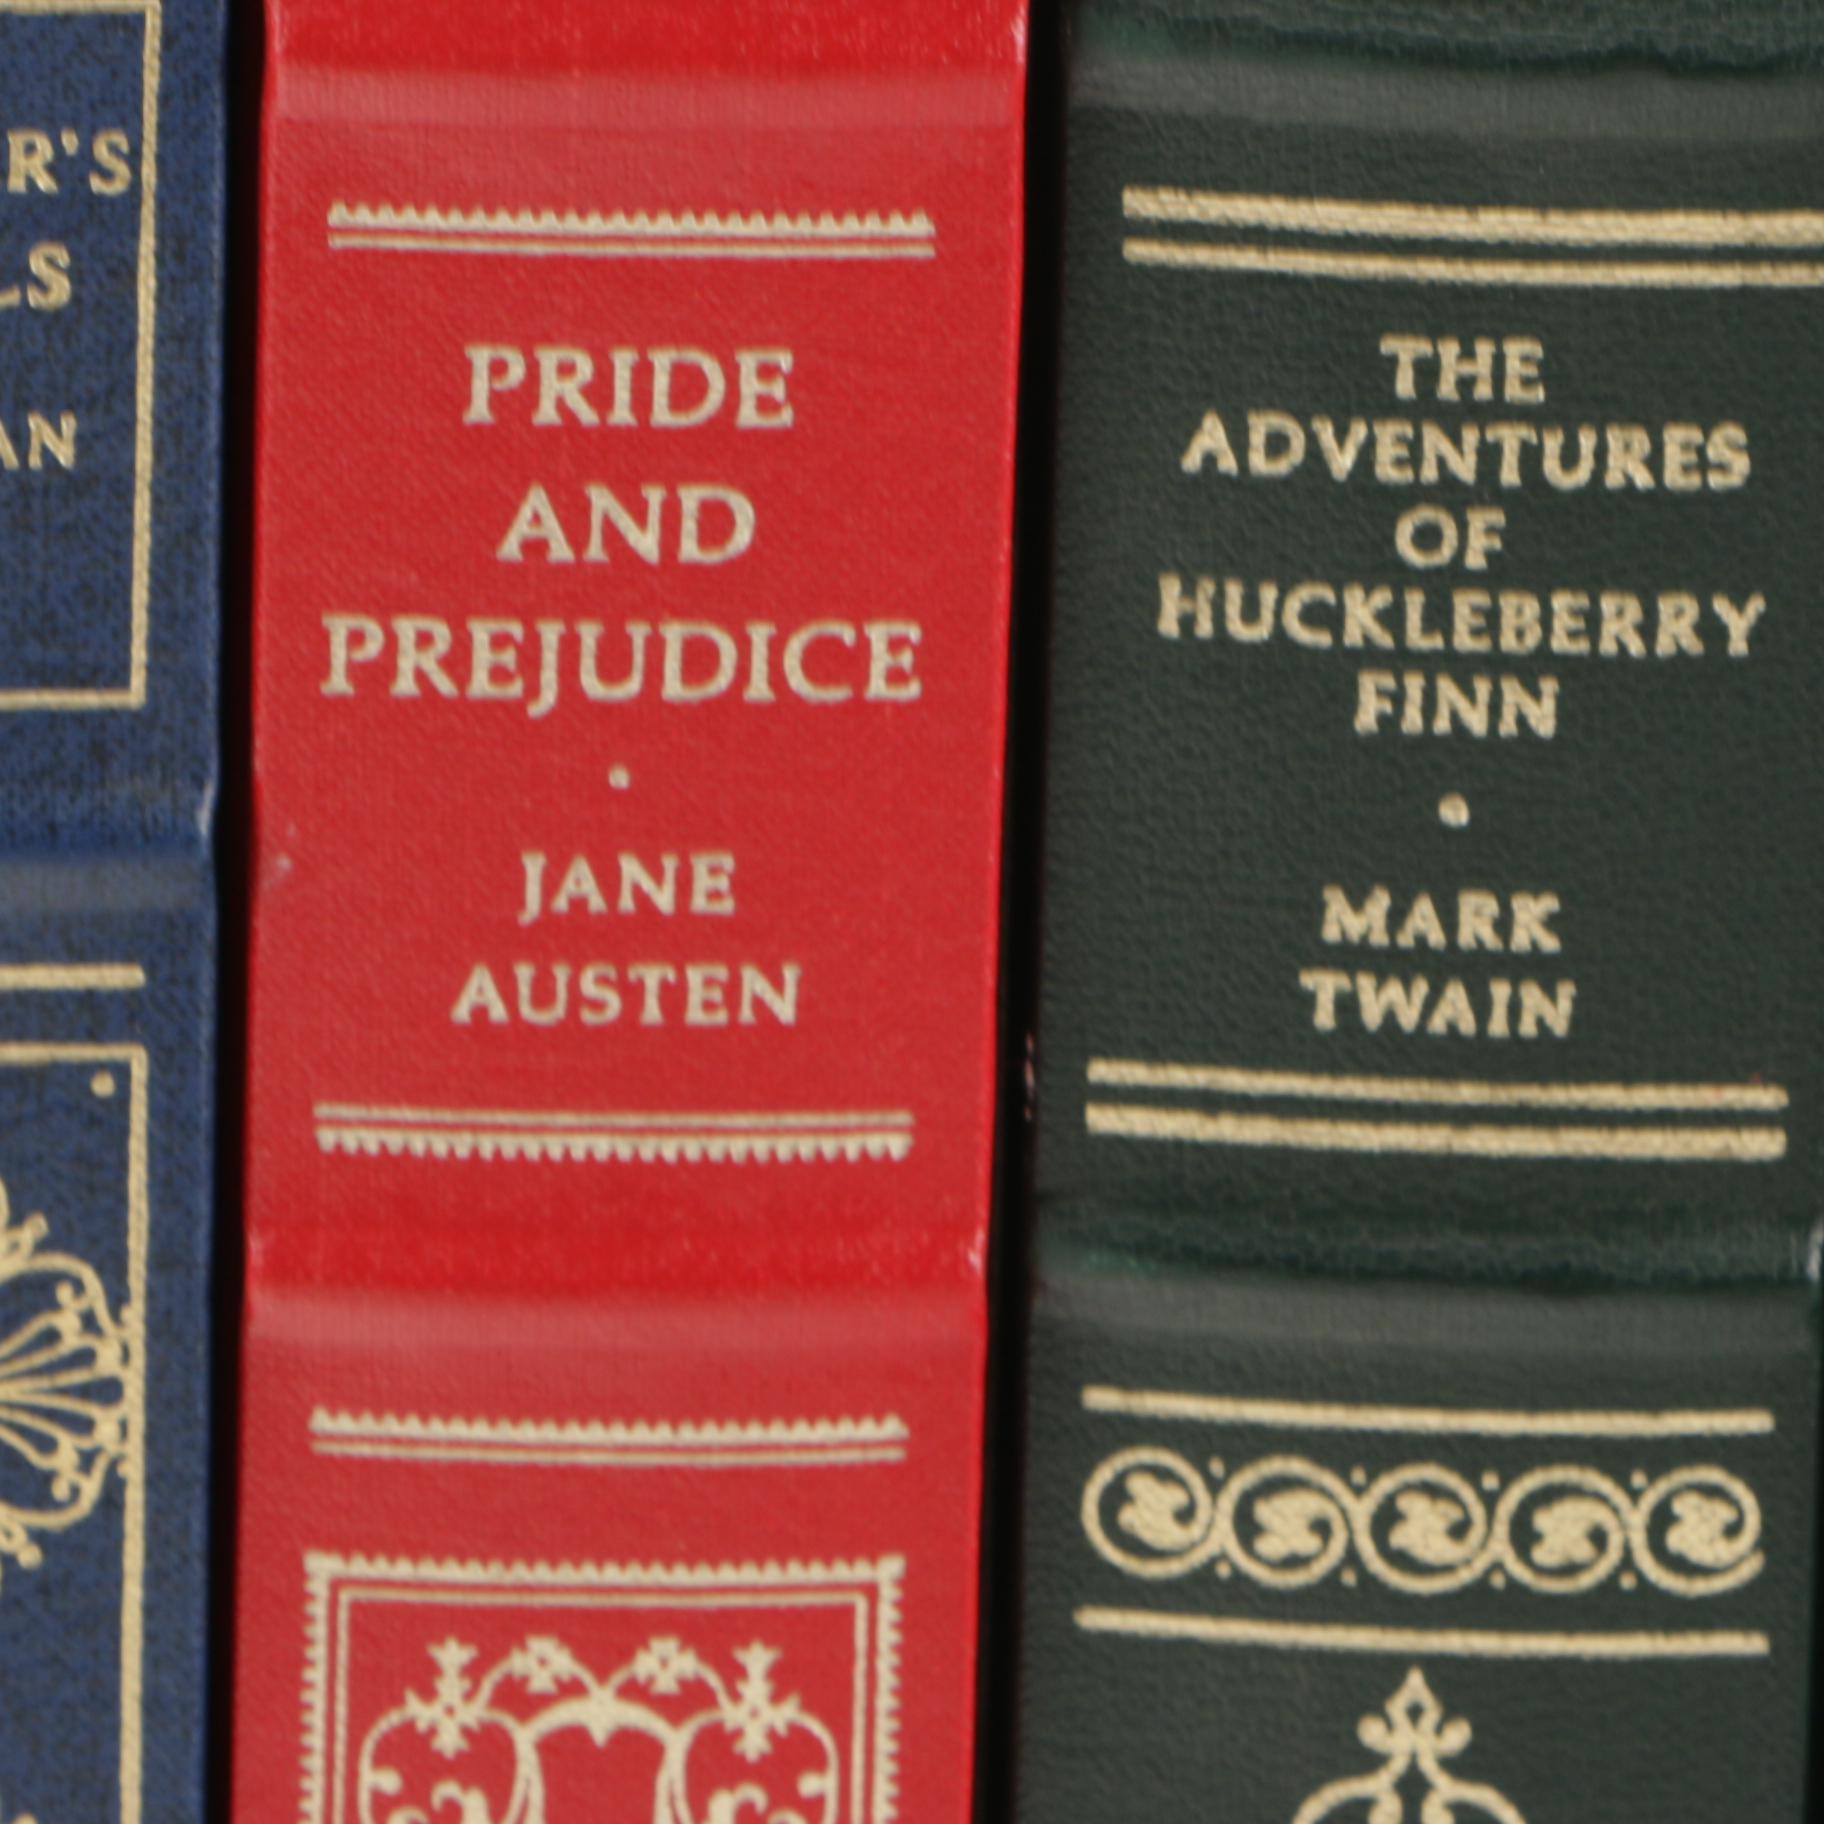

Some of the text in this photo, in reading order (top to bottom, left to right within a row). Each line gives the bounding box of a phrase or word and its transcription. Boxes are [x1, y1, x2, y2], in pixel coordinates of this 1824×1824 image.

[463, 344, 794, 428] PRIDE
[1380, 336, 1545, 404] THE
[1181, 411, 1750, 490] ADVENTURES
[496, 483, 756, 564] AND
[1395, 505, 1506, 570] OF
[1157, 574, 1765, 658] HUCKLEBERRY
[320, 613, 922, 718] PREJUDICE
[1354, 671, 1559, 738] FINN
[519, 851, 735, 925] JANE
[1322, 887, 1561, 953] MARK
[451, 962, 801, 1026] AUSTEN
[1299, 970, 1576, 1038] TWAIN
